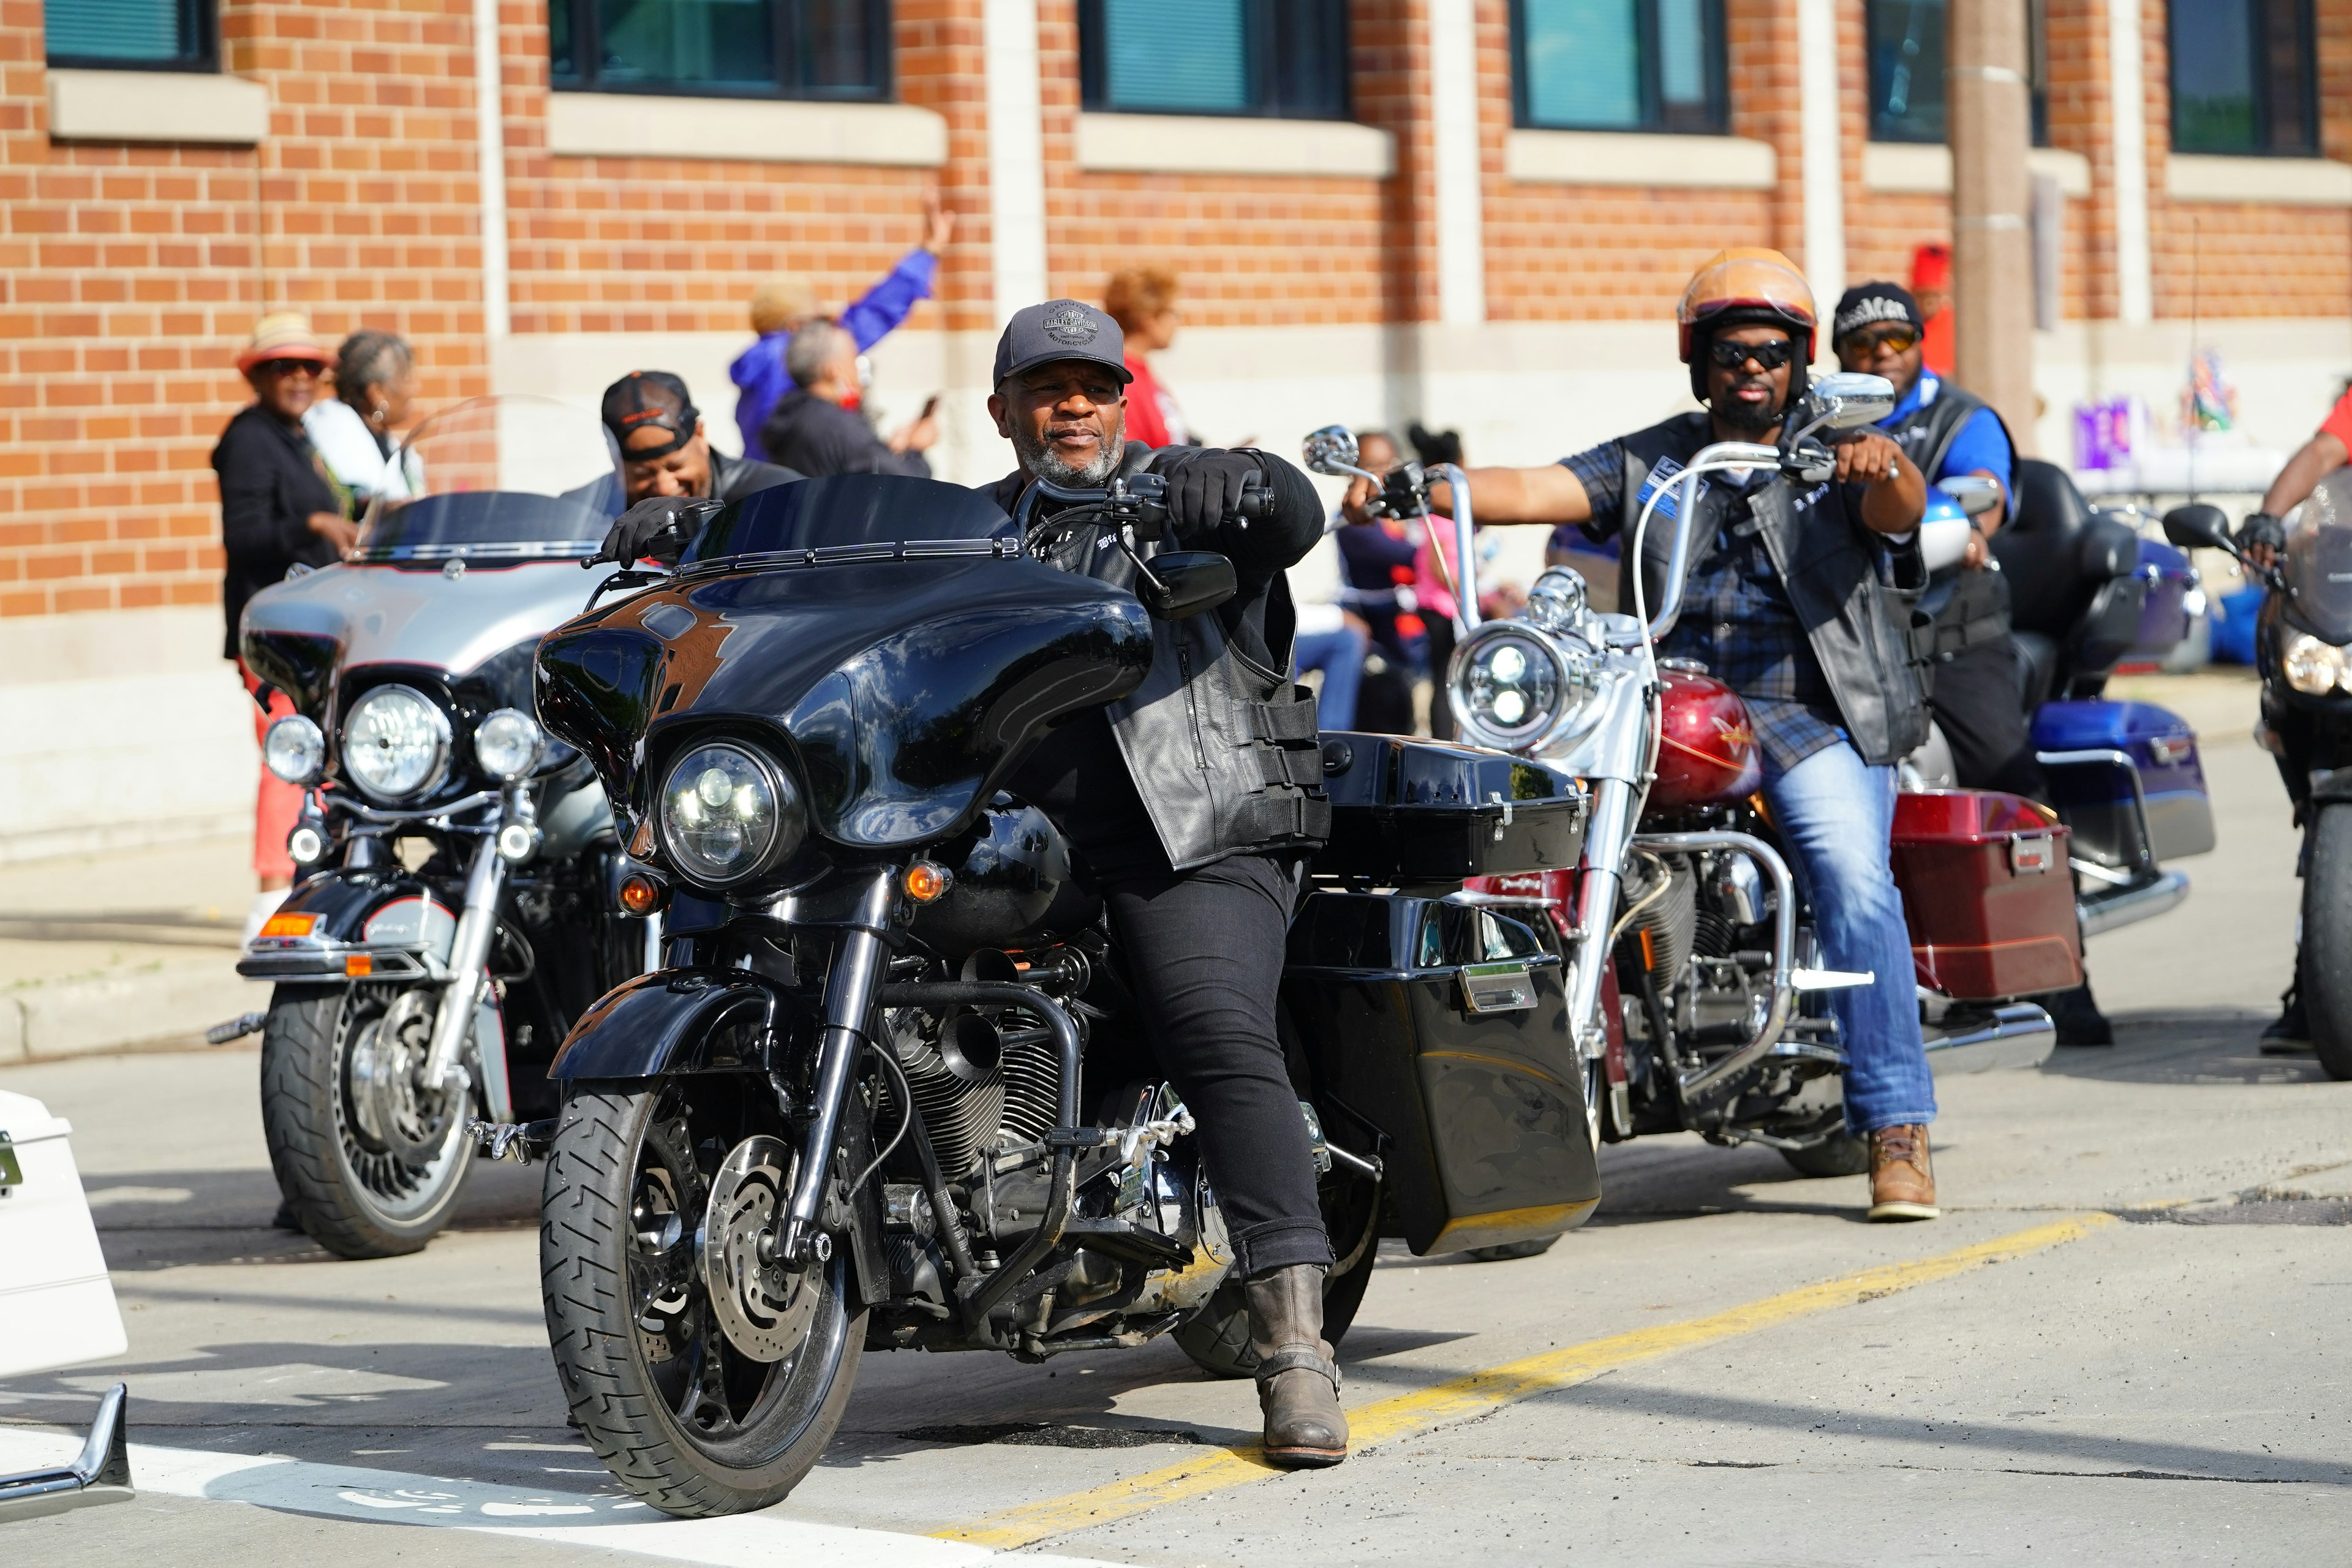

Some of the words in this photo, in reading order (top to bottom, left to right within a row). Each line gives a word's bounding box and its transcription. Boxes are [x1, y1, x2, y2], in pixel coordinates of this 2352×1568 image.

[1049, 302, 1090, 315] GENUINE
[1046, 318, 1096, 329] HARLEY-DAVIDSON
[1048, 332, 1096, 346] MOTORCYCLES
